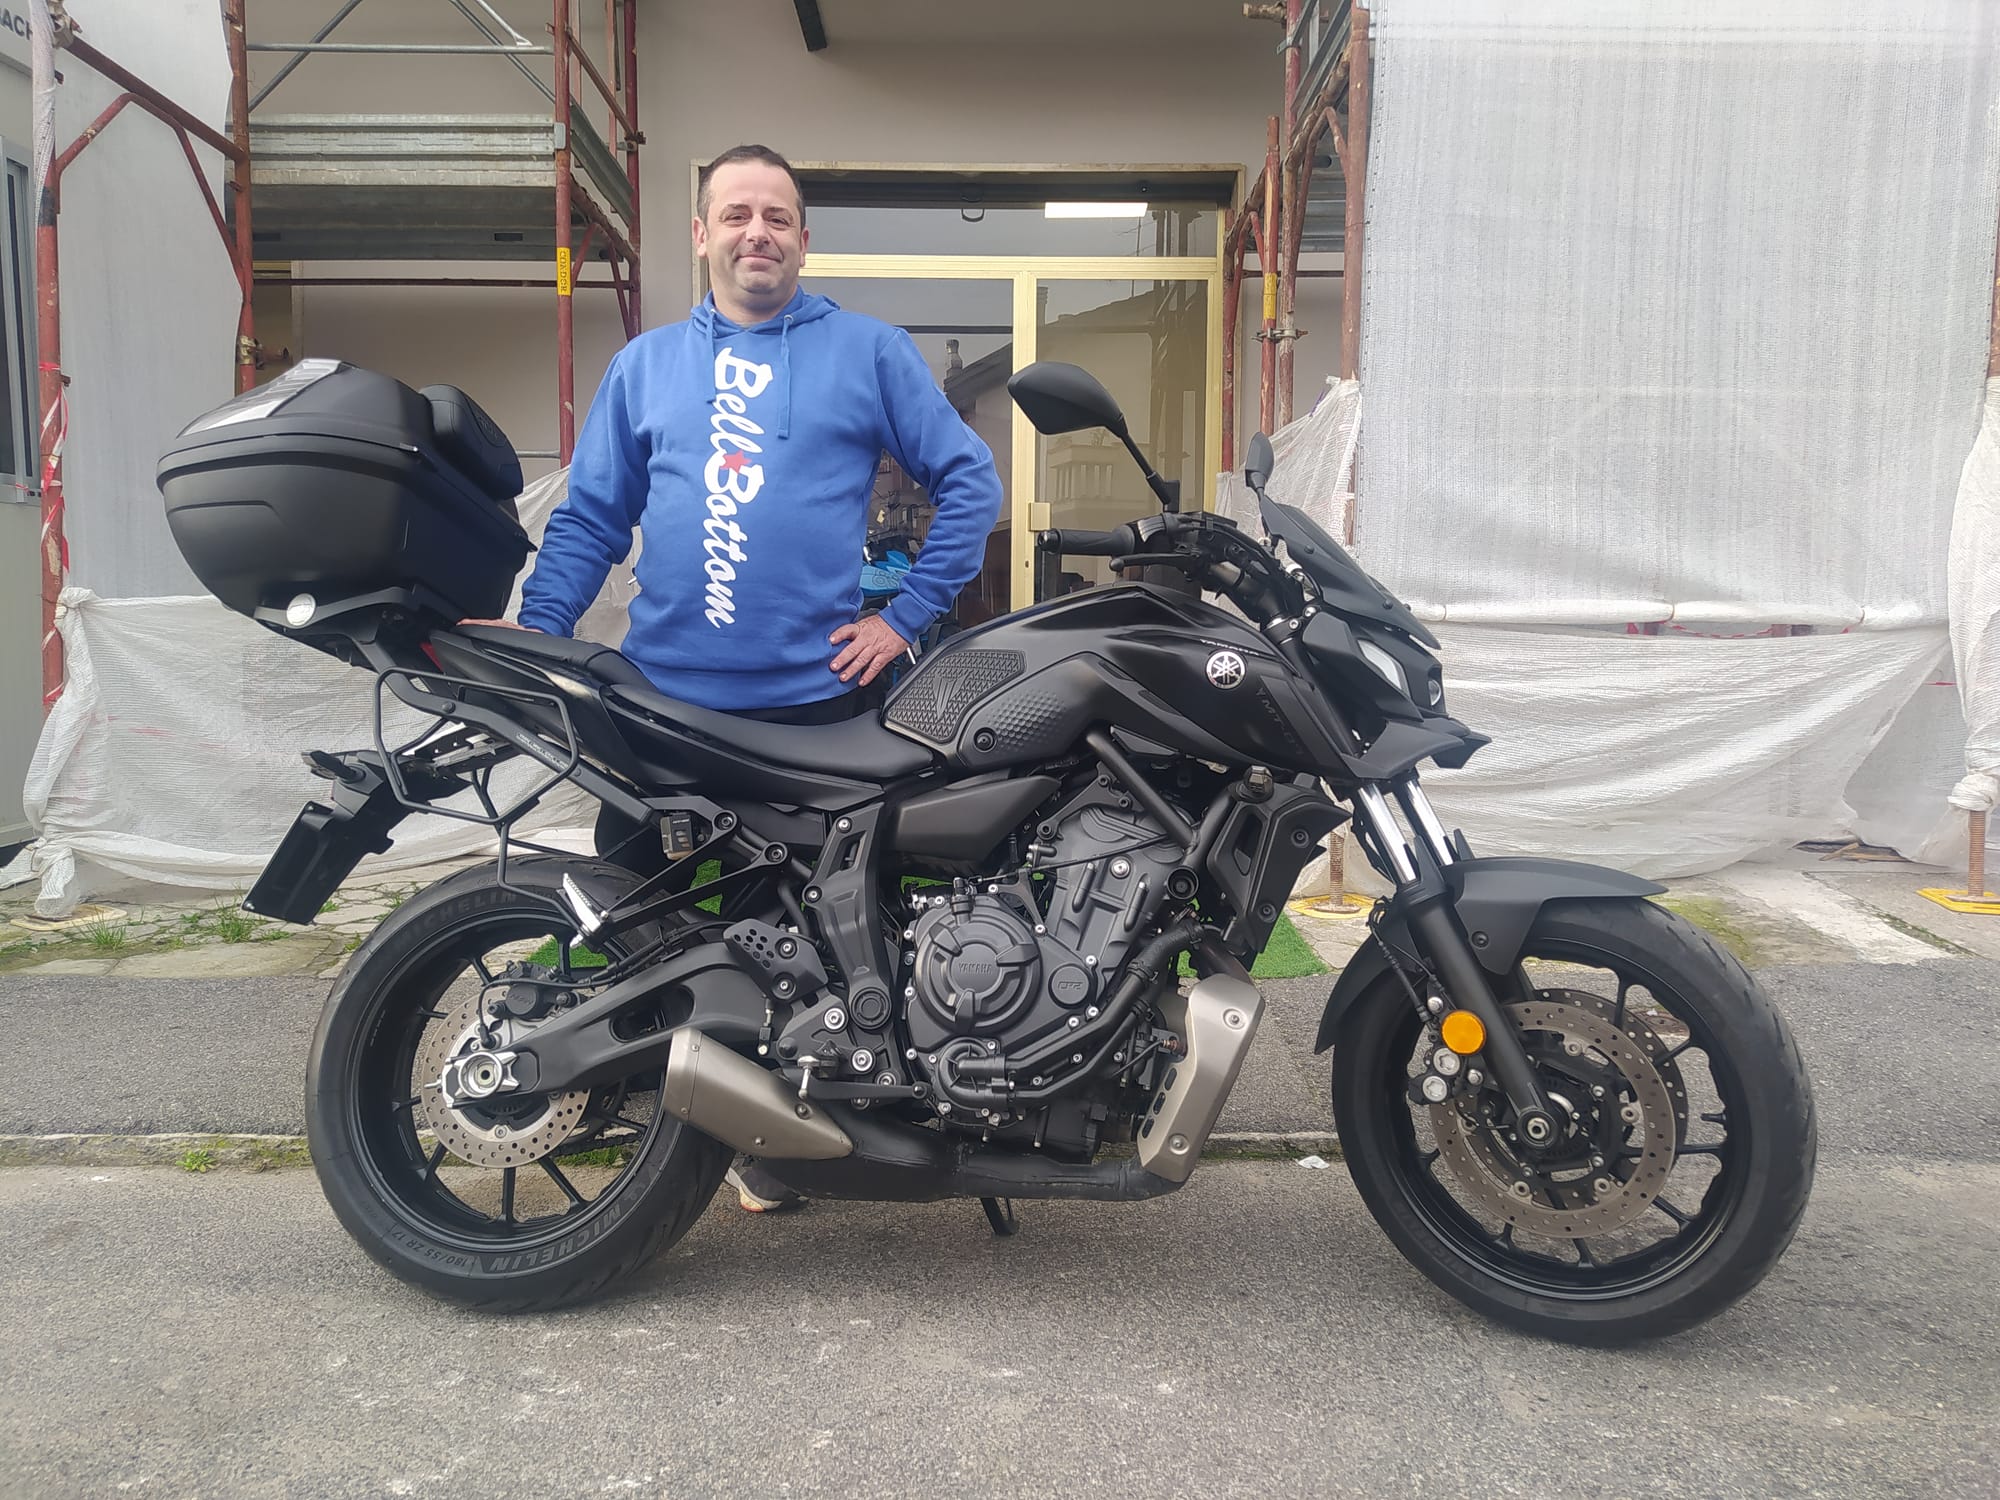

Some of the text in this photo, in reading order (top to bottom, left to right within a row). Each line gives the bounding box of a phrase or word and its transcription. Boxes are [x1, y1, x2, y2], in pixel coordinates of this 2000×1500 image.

[703, 346, 774, 629] Bell Bottom
[958, 961, 993, 975] YAMAHA
[489, 1202, 622, 1272] MICHELIN
